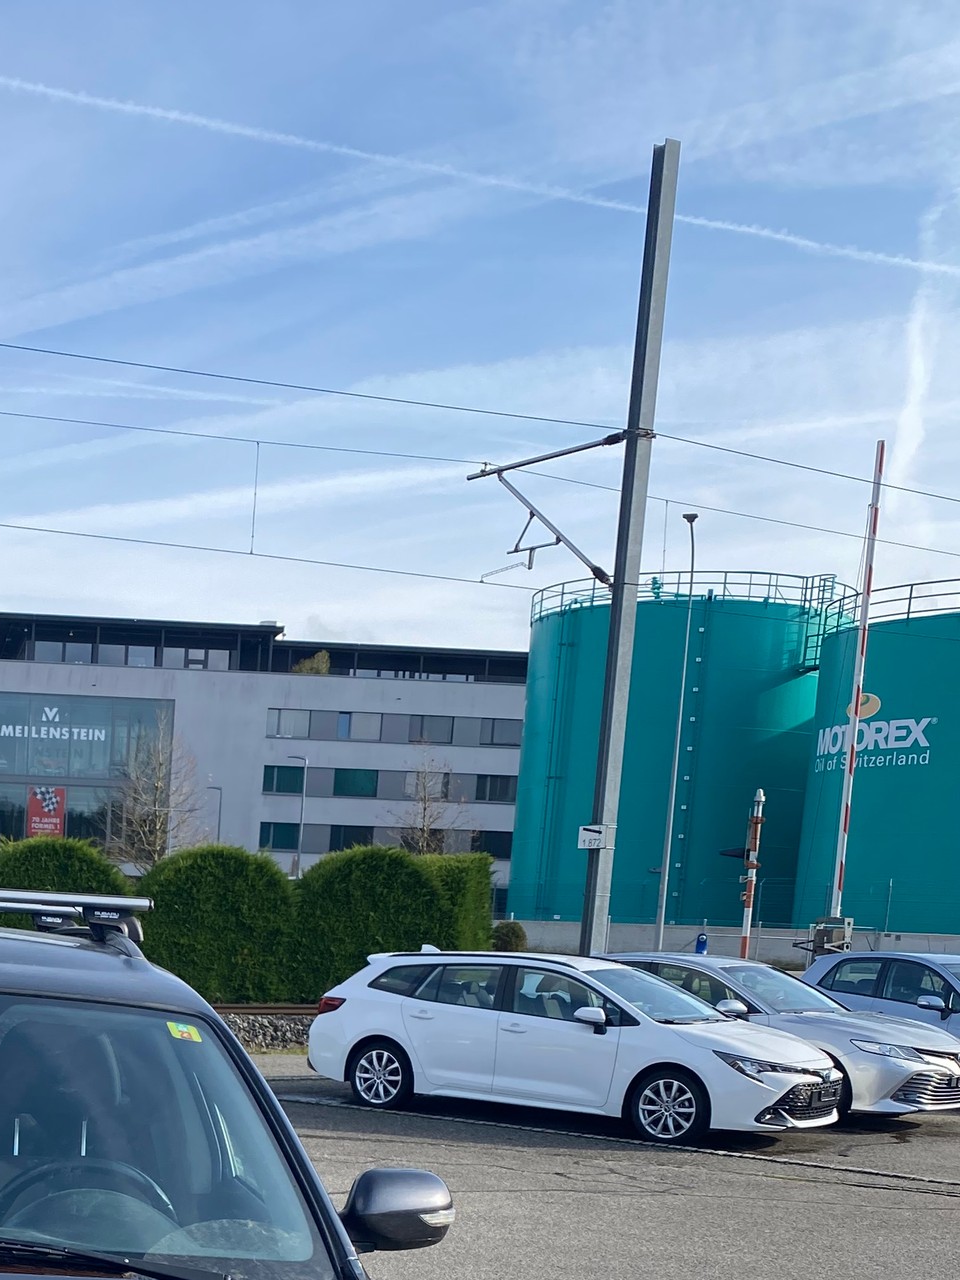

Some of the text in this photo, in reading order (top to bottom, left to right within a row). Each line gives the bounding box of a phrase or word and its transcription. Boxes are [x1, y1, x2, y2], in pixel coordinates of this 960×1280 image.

[0, 724, 106, 741] MEILENSTEIN
[815, 758, 825, 773] Oil
[826, 755, 837, 771] of
